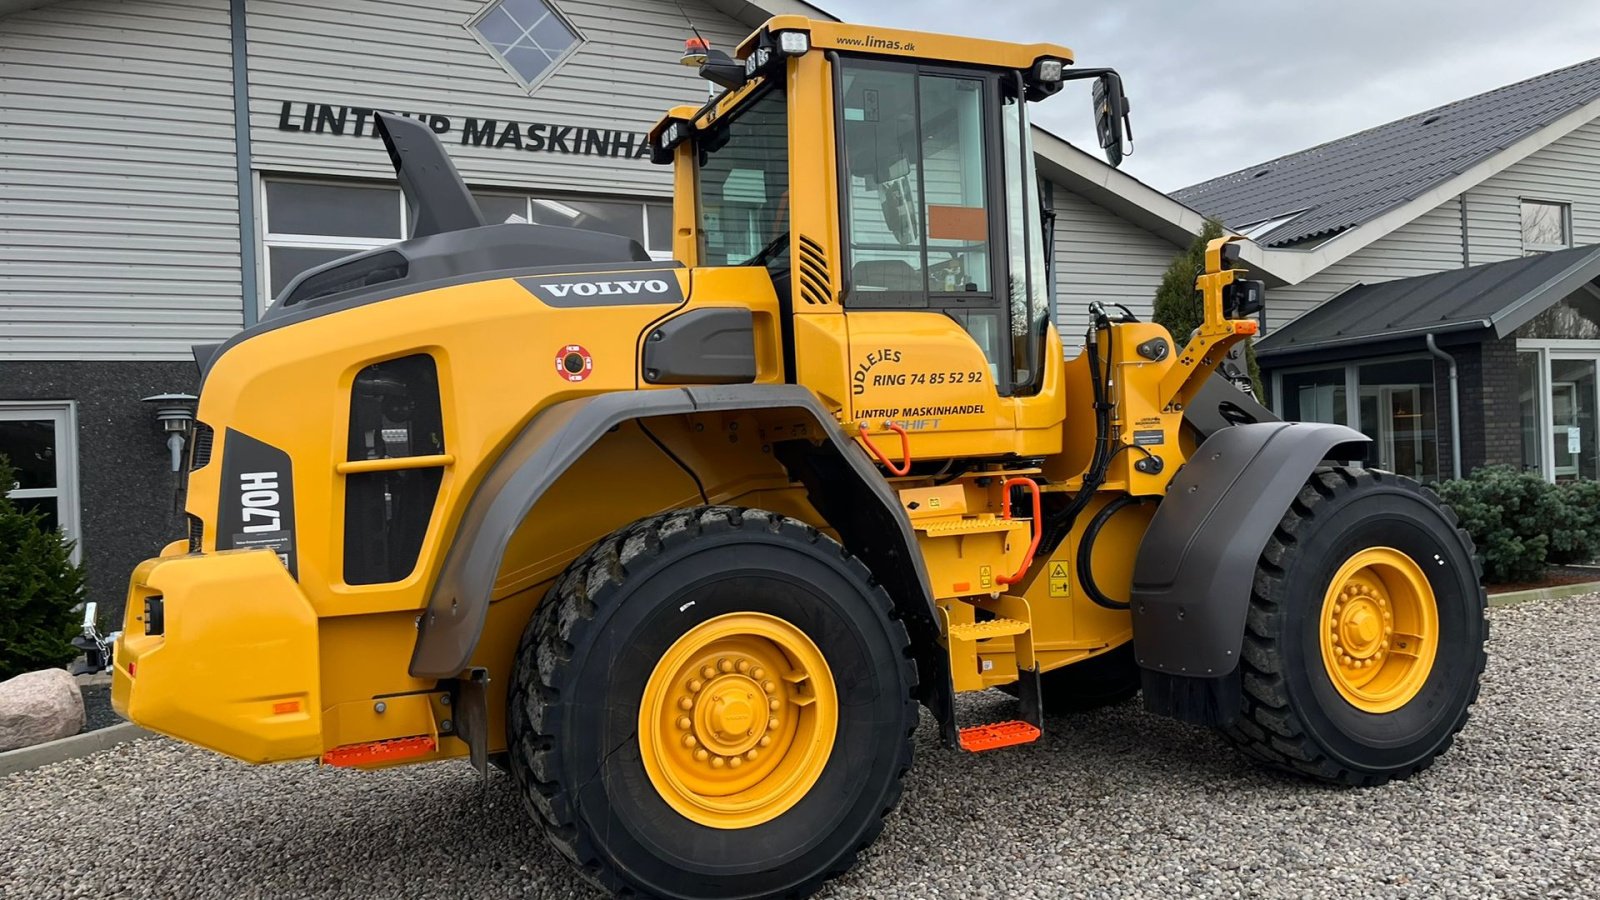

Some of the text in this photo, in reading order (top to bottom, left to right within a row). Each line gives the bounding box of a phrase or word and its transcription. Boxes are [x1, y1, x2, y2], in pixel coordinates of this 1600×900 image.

[836, 35, 915, 51] www.limas.dk
[279, 100, 450, 139] LINTP
[539, 279, 669, 297] VOLVO
[854, 349, 902, 395] UDLEJES
[873, 371, 983, 386] RING 74 85 52 92
[855, 405, 985, 419] LINTRUP MASKINHANDEL
[240, 471, 281, 533] L70H
